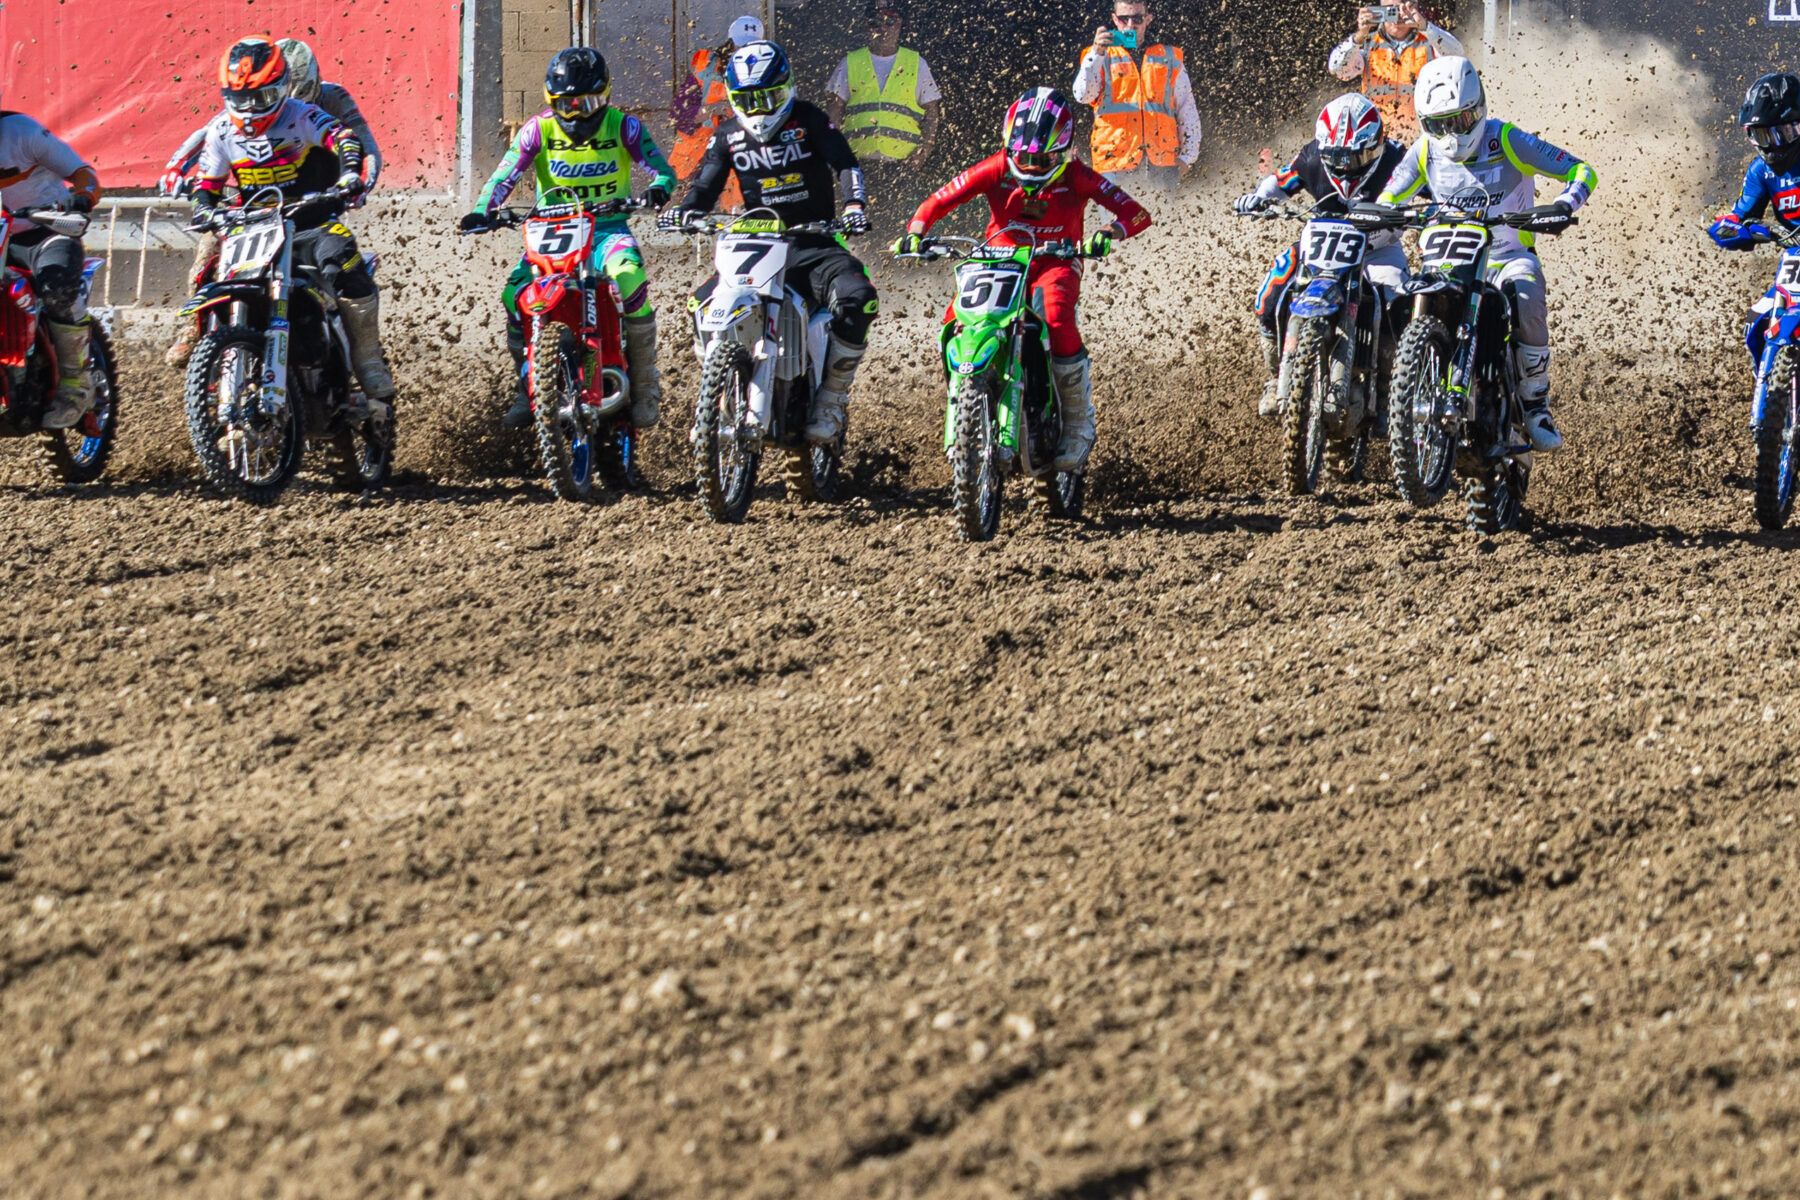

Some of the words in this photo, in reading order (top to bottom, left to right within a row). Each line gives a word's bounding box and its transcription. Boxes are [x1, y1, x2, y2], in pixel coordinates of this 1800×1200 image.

[548, 138, 618, 152] Beta
[233, 227, 279, 262] 111
[538, 220, 579, 255] 5
[1308, 230, 1366, 265] 313
[732, 243, 774, 275] 7
[960, 273, 1019, 310] 51
